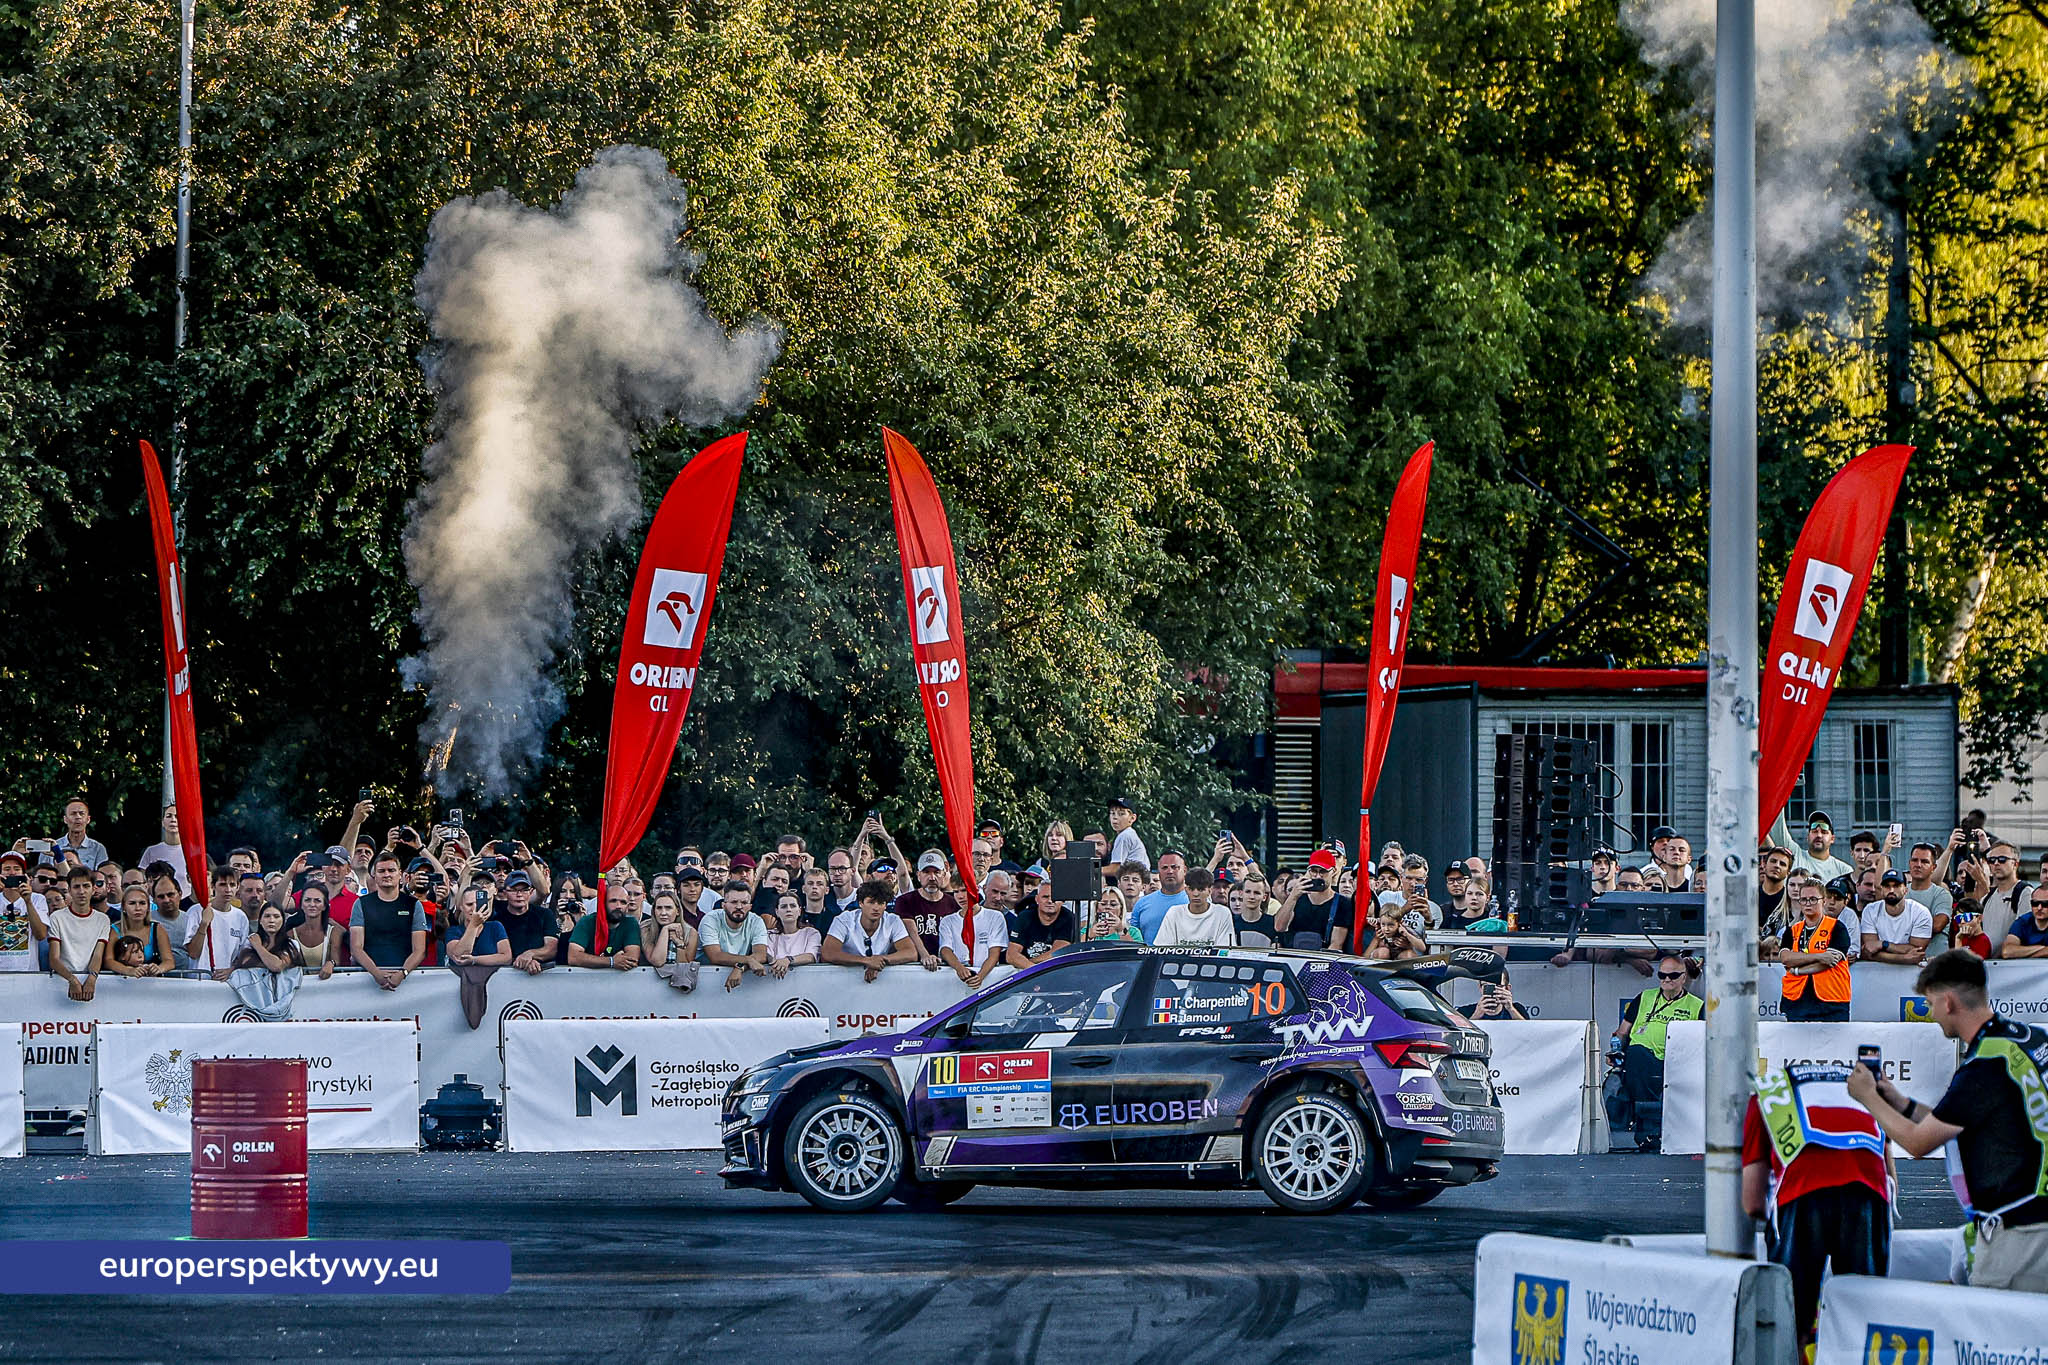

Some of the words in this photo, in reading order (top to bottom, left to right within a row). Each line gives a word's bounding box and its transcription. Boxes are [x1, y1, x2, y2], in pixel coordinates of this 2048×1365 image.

[1137, 947, 1211, 956] SIMUMOTION
[1412, 960, 1447, 970] SKODA
[1172, 998, 1182, 1009] T.
[1185, 994, 1249, 1010] Charpentier
[1248, 982, 1286, 1016] 10
[24, 1046, 79, 1065] ADION
[650, 1059, 740, 1076] Górnośląsko
[933, 1056, 955, 1084] 10
[1003, 1059, 1033, 1068] ORLEN
[307, 1075, 373, 1096] urystyki
[981, 1083, 1021, 1092] Championship
[751, 1096, 770, 1108] OMP
[1095, 1099, 1218, 1126] EUROBEN
[1465, 1115, 1497, 1131] EUROBEN
[232, 1142, 275, 1153] ORLEN
[233, 1155, 248, 1163] OIL
[1586, 1289, 1697, 1335] Województwo
